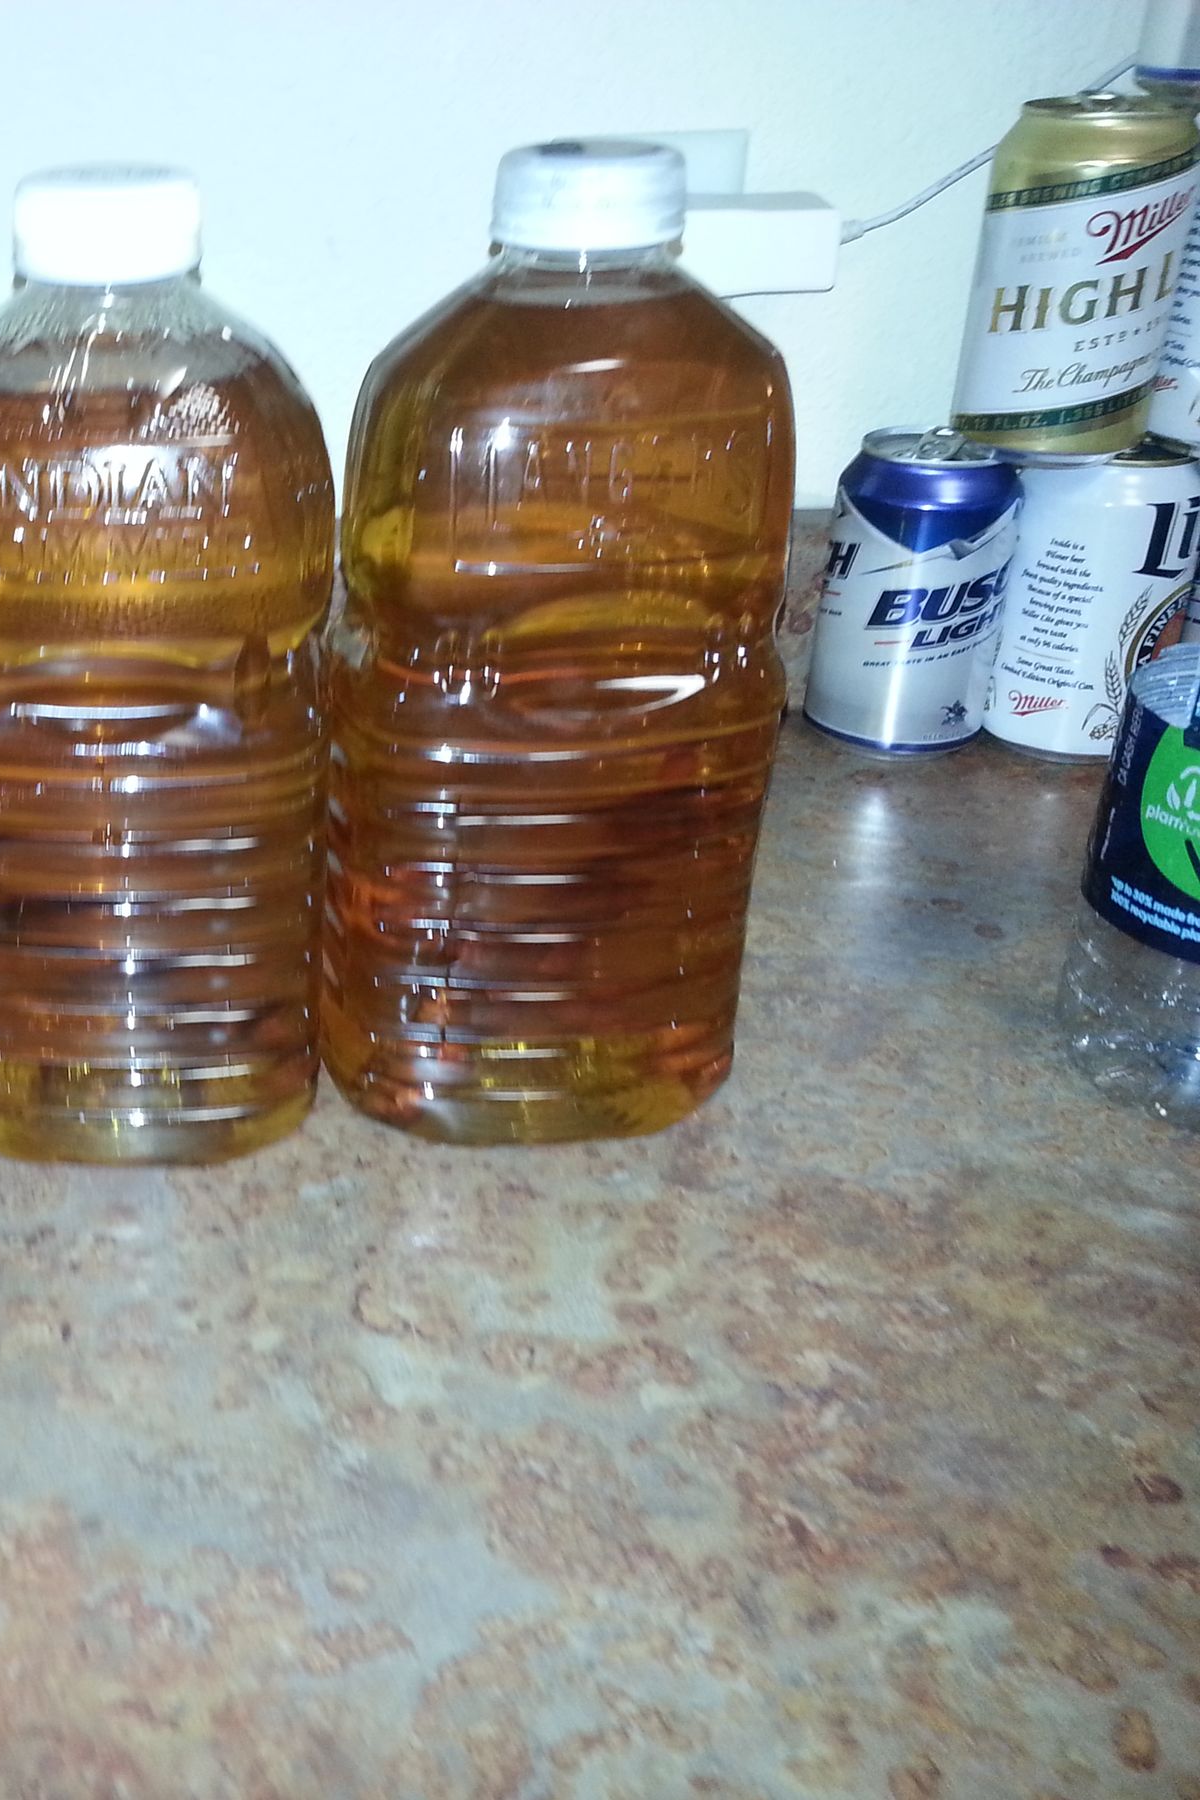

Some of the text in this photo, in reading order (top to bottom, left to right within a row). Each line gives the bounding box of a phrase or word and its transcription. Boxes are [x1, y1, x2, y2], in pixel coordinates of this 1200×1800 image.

[1085, 184, 1196, 265] Miller
[1012, 349, 1156, 393] The Champag
[1008, 689, 1067, 716] Miller
[1130, 904, 1180, 935] recyclable
[1153, 900, 1186, 922] made
